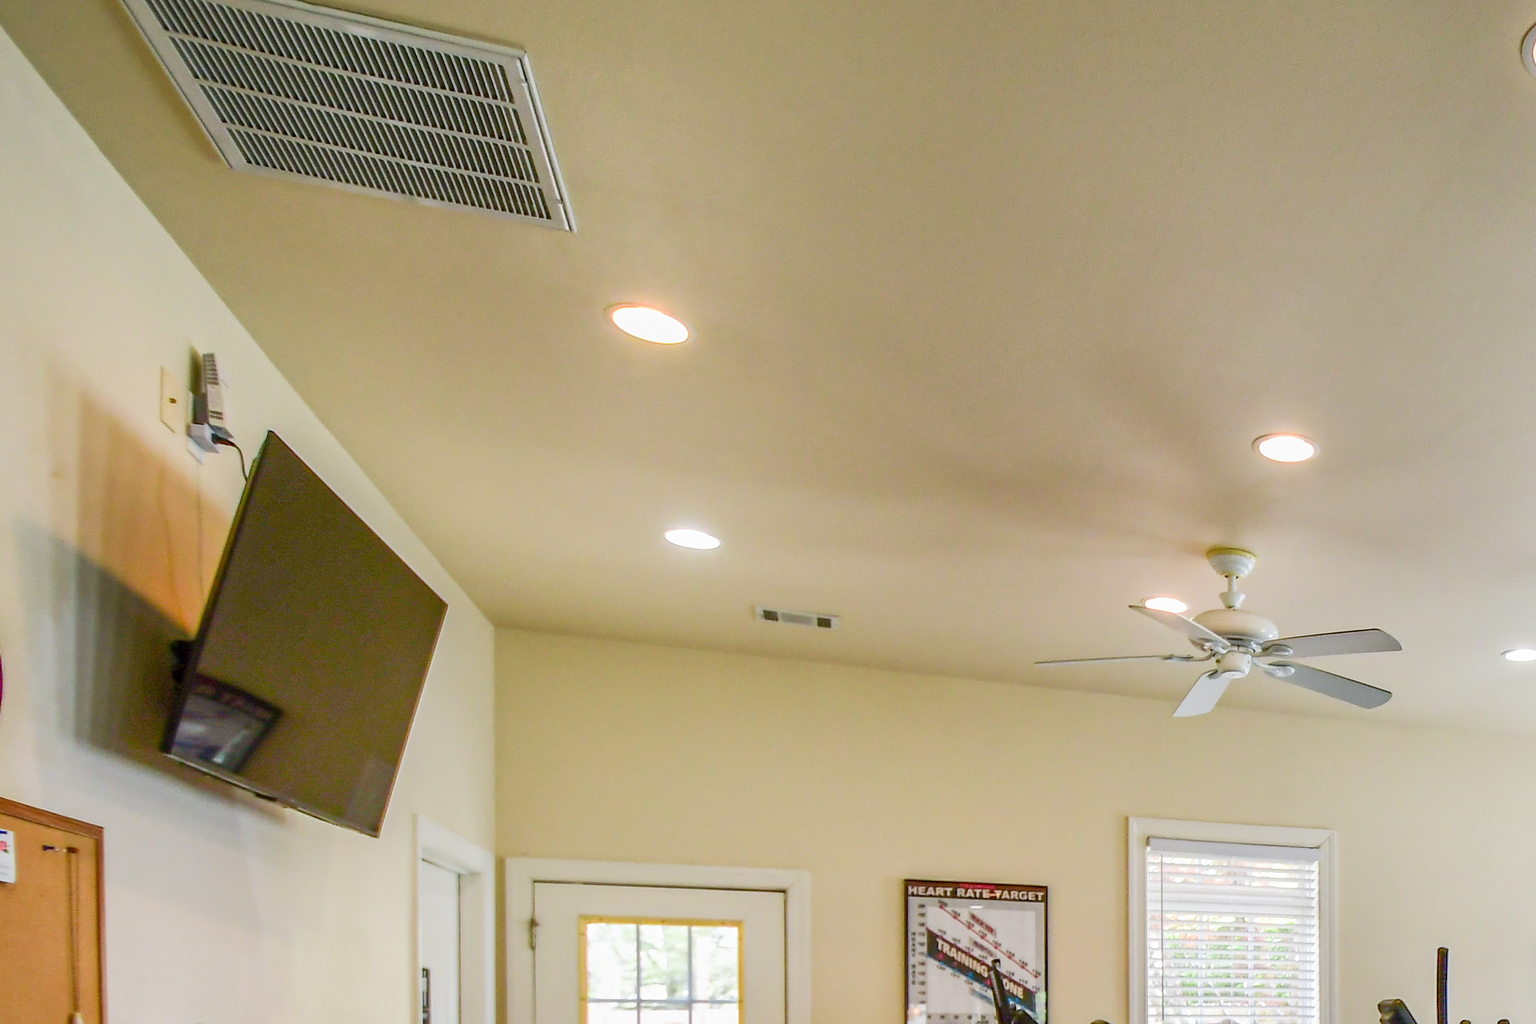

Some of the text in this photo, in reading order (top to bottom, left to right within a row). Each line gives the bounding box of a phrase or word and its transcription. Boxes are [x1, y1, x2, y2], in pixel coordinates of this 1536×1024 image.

[907, 885, 953, 896] HEART
[956, 887, 990, 899] RATE
[994, 889, 1044, 901] TARGET
[936, 937, 989, 978] TRAINING
[1002, 977, 1025, 999] ONE
